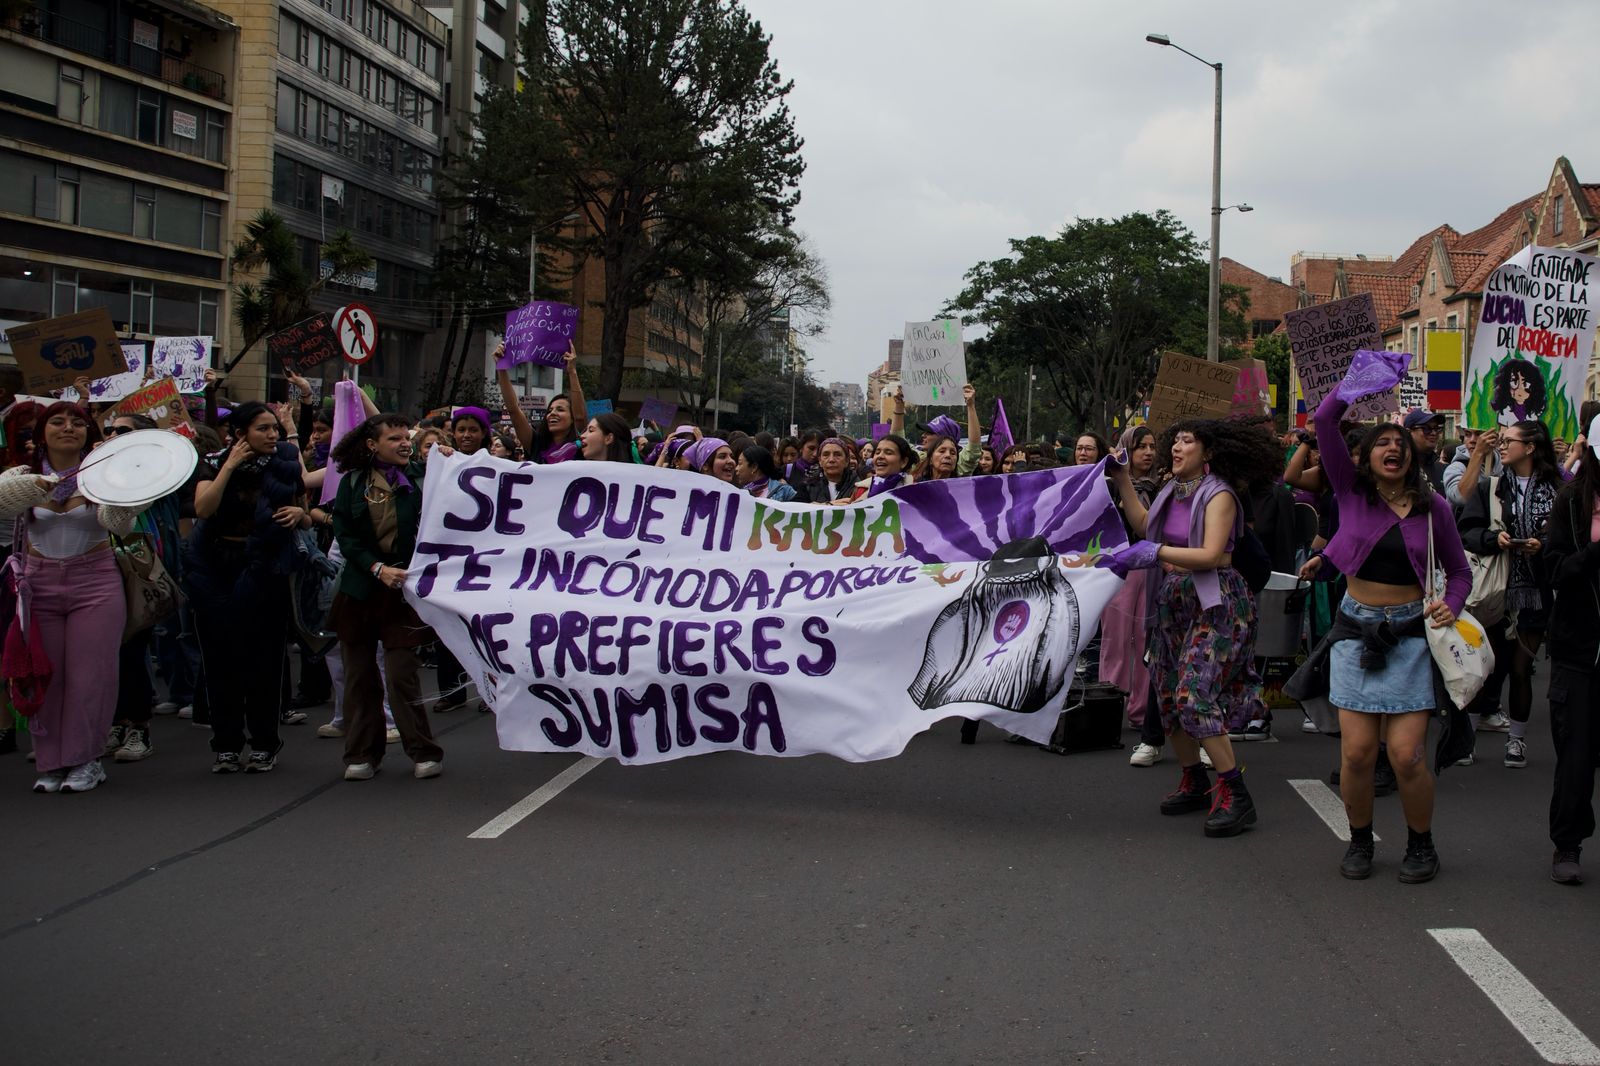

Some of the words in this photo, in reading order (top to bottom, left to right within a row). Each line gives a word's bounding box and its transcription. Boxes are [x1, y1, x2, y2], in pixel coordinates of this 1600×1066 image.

[1488, 269, 1503, 292] EL
[1503, 272, 1541, 298] MOTIVO
[1544, 283, 1565, 302] DE
[1569, 283, 1588, 305] LA
[1531, 253, 1596, 286] ENTIENDE
[1482, 292, 1528, 327] LUCHA
[1533, 304, 1555, 331] ES
[1556, 306, 1592, 331] PARTE
[1497, 326, 1515, 349] DEL
[1517, 326, 1578, 359] PROBLEMA
[557, 476, 677, 544] QUE
[680, 488, 741, 551] MI
[747, 498, 905, 558] RABIA
[416, 542, 505, 598] TE
[509, 548, 775, 612] INCÓMODA
[774, 563, 920, 609] PORQUE
[525, 610, 837, 678] PREFIERES
[528, 682, 787, 758] SUMISA
